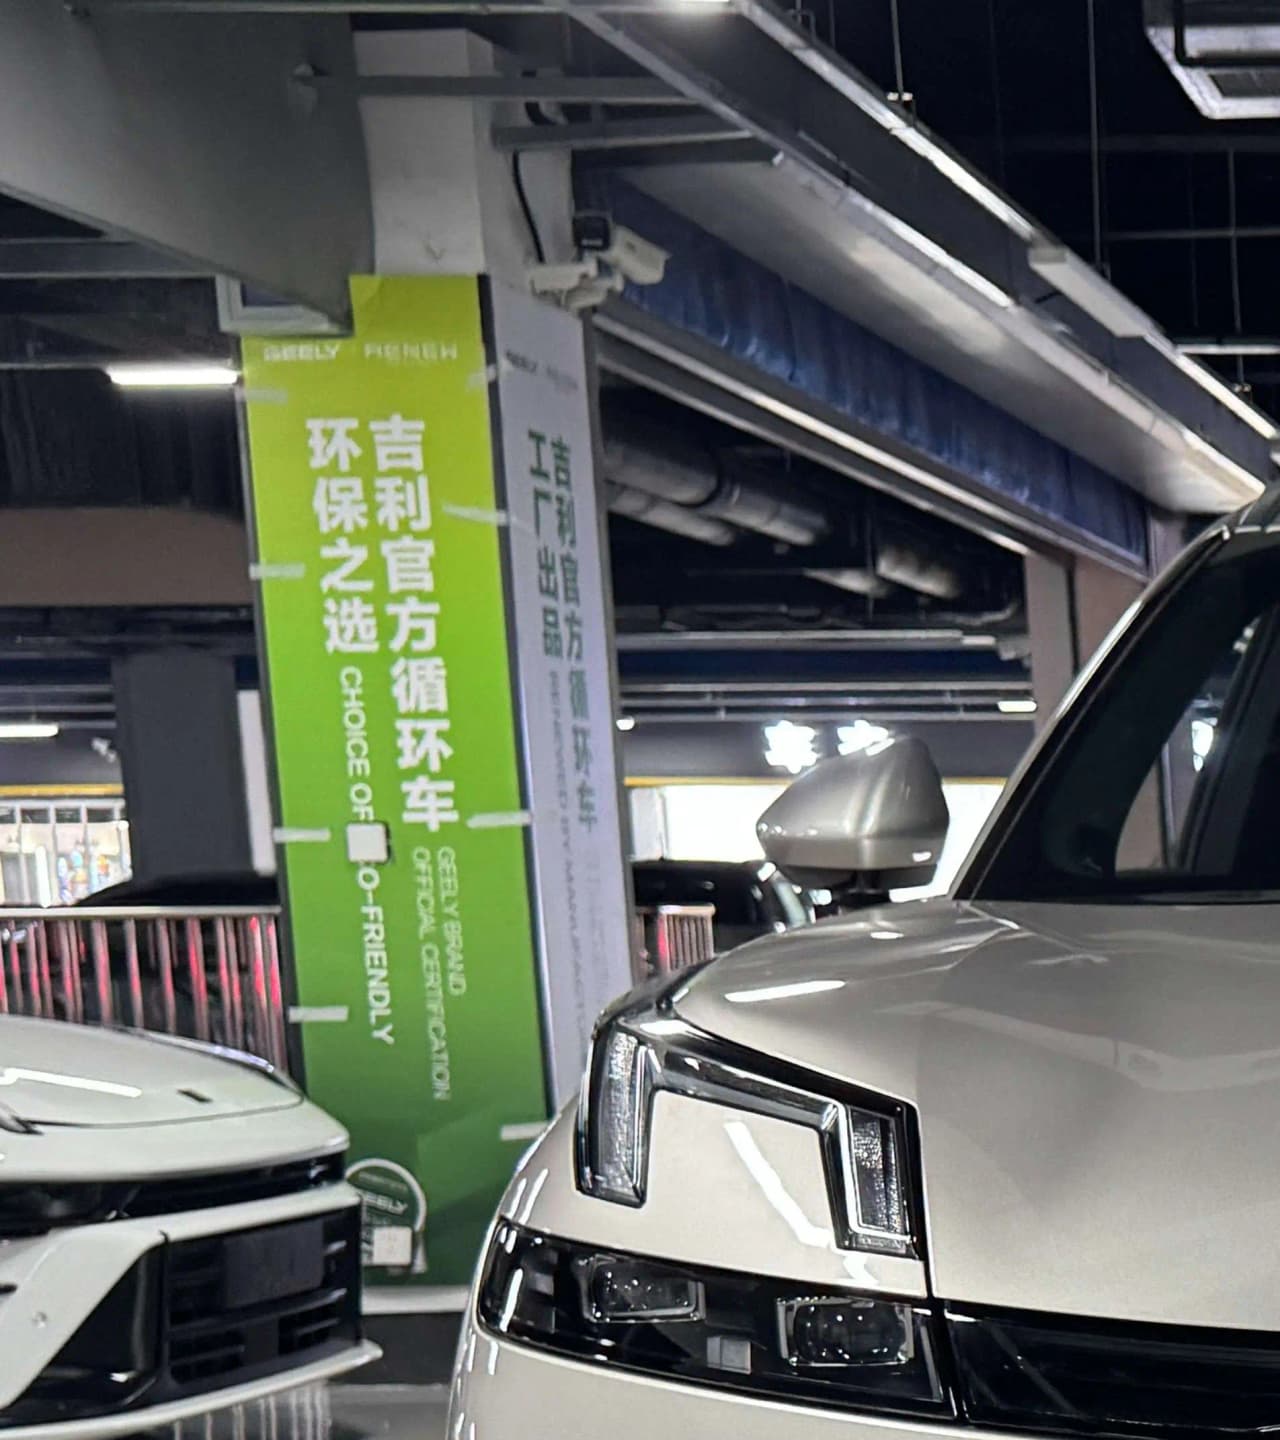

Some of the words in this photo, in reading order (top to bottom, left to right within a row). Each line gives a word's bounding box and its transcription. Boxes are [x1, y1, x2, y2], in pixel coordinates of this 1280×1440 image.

[305, 417, 379, 654] 环保之选
[369, 413, 460, 832] 吉利官方循环车
[528, 429, 563, 658] 工厂出品
[340, 666, 371, 777] CHOICE
[350, 782, 375, 821] OF
[357, 862, 395, 1045] O-FRIENDLY
